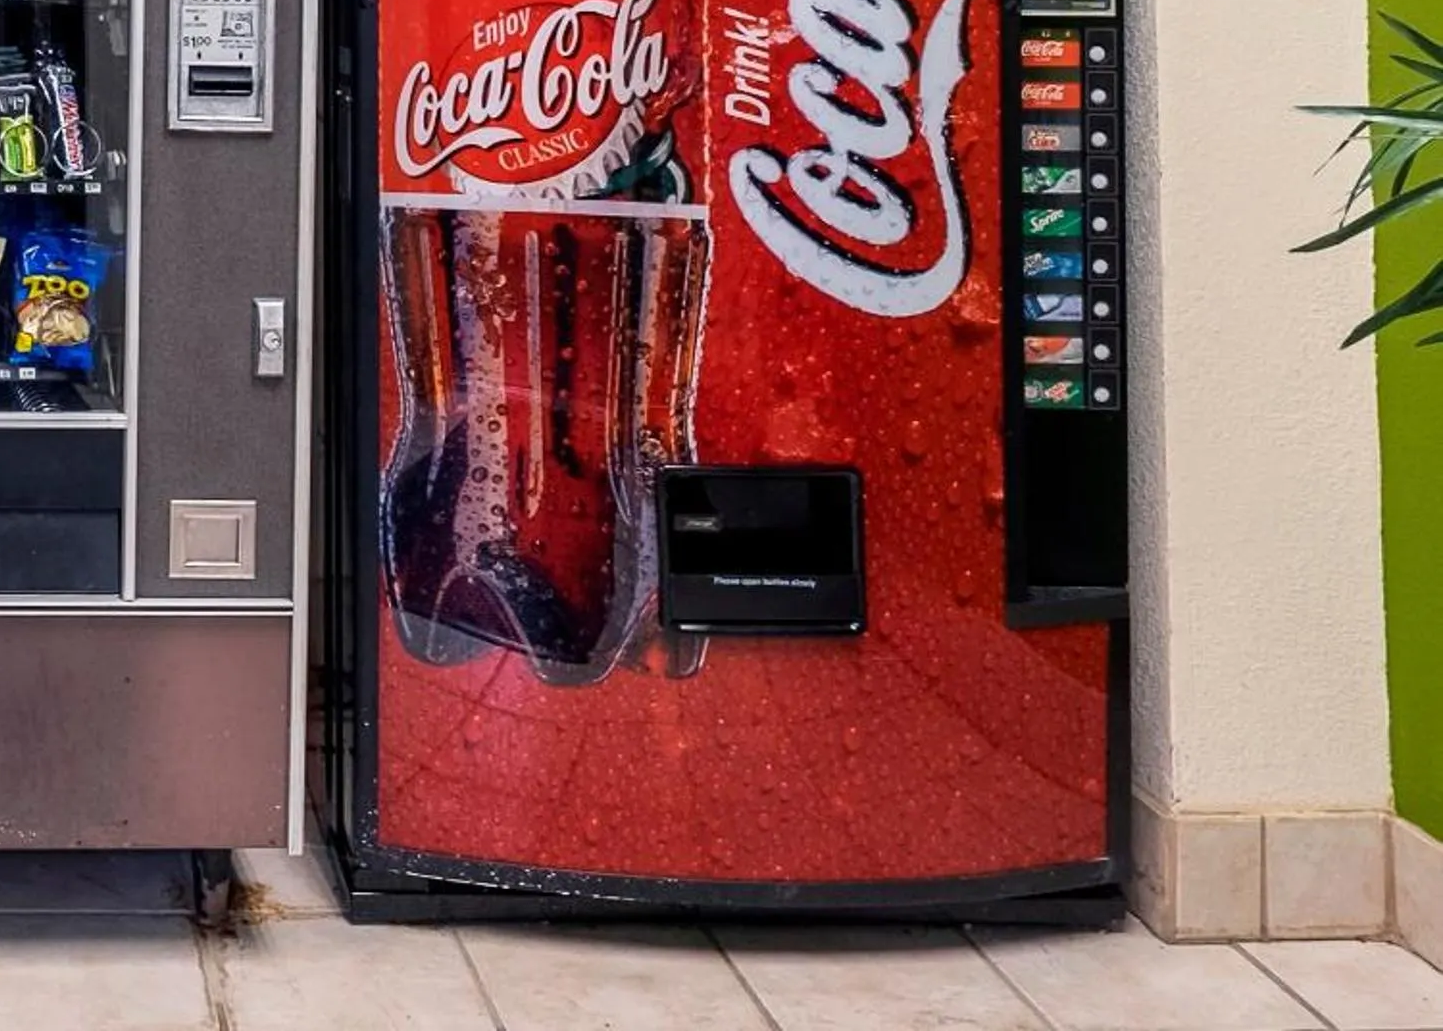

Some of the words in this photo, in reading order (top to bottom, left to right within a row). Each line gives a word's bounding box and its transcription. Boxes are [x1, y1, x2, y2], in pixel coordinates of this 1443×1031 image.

[473, 6, 531, 51] Enjoy
[724, 7, 773, 127] Drink!
[498, 128, 590, 172] CLASSIC
[1030, 209, 1065, 233] Sprite
[22, 274, 91, 300] ZOO
